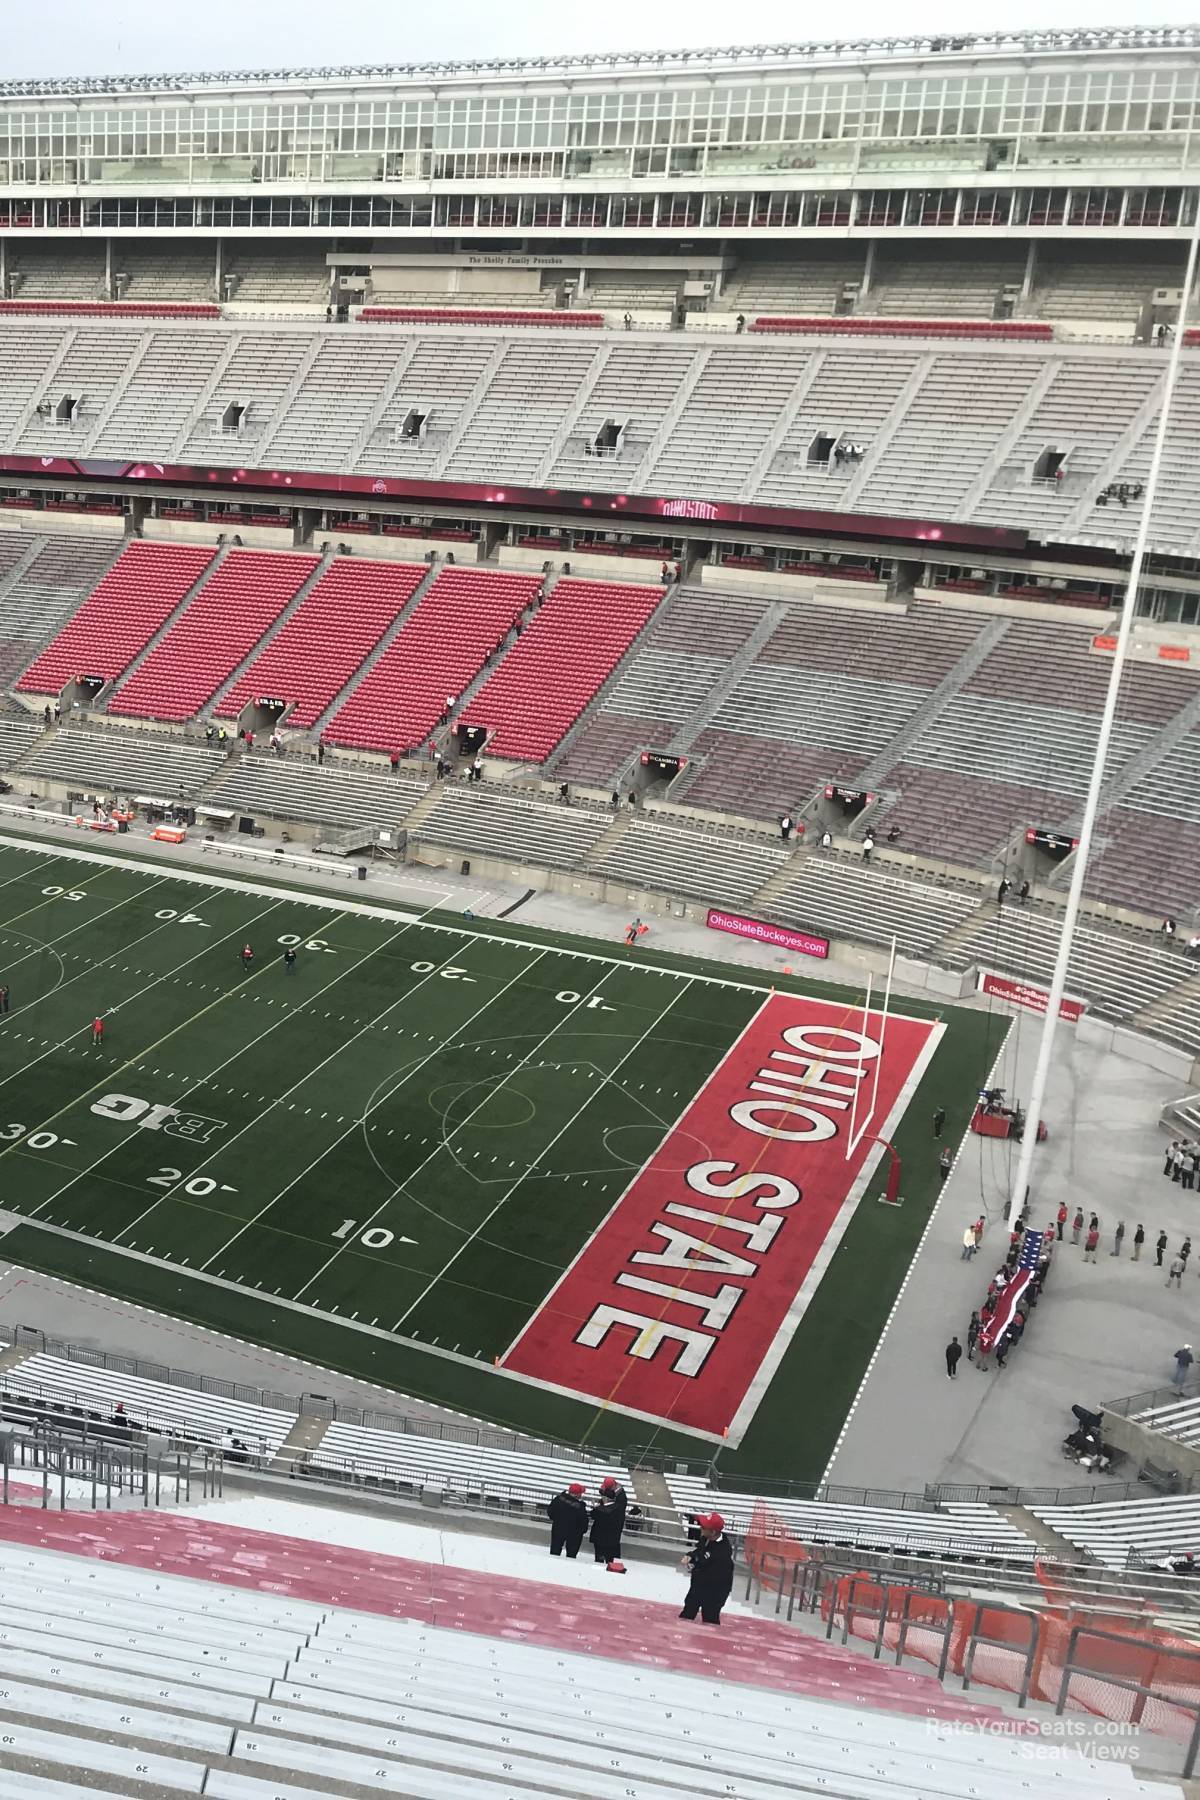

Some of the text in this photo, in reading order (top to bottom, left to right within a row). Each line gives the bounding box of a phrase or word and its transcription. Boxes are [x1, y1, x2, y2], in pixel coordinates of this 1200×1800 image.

[41, 885, 88, 902] 50
[154, 908, 203, 925] 40
[277, 933, 327, 952] 30
[710, 914, 826, 956] OhioStateBuckeyes.com
[409, 960, 469, 980] 20
[554, 989, 607, 1010] 10
[146, 1167, 218, 1197] 20
[573, 1024, 885, 1379] OHIO STATE
[330, 1219, 395, 1249] 10
[2, 1735, 16, 1744] 30
[135, 1765, 149, 1774] 29
